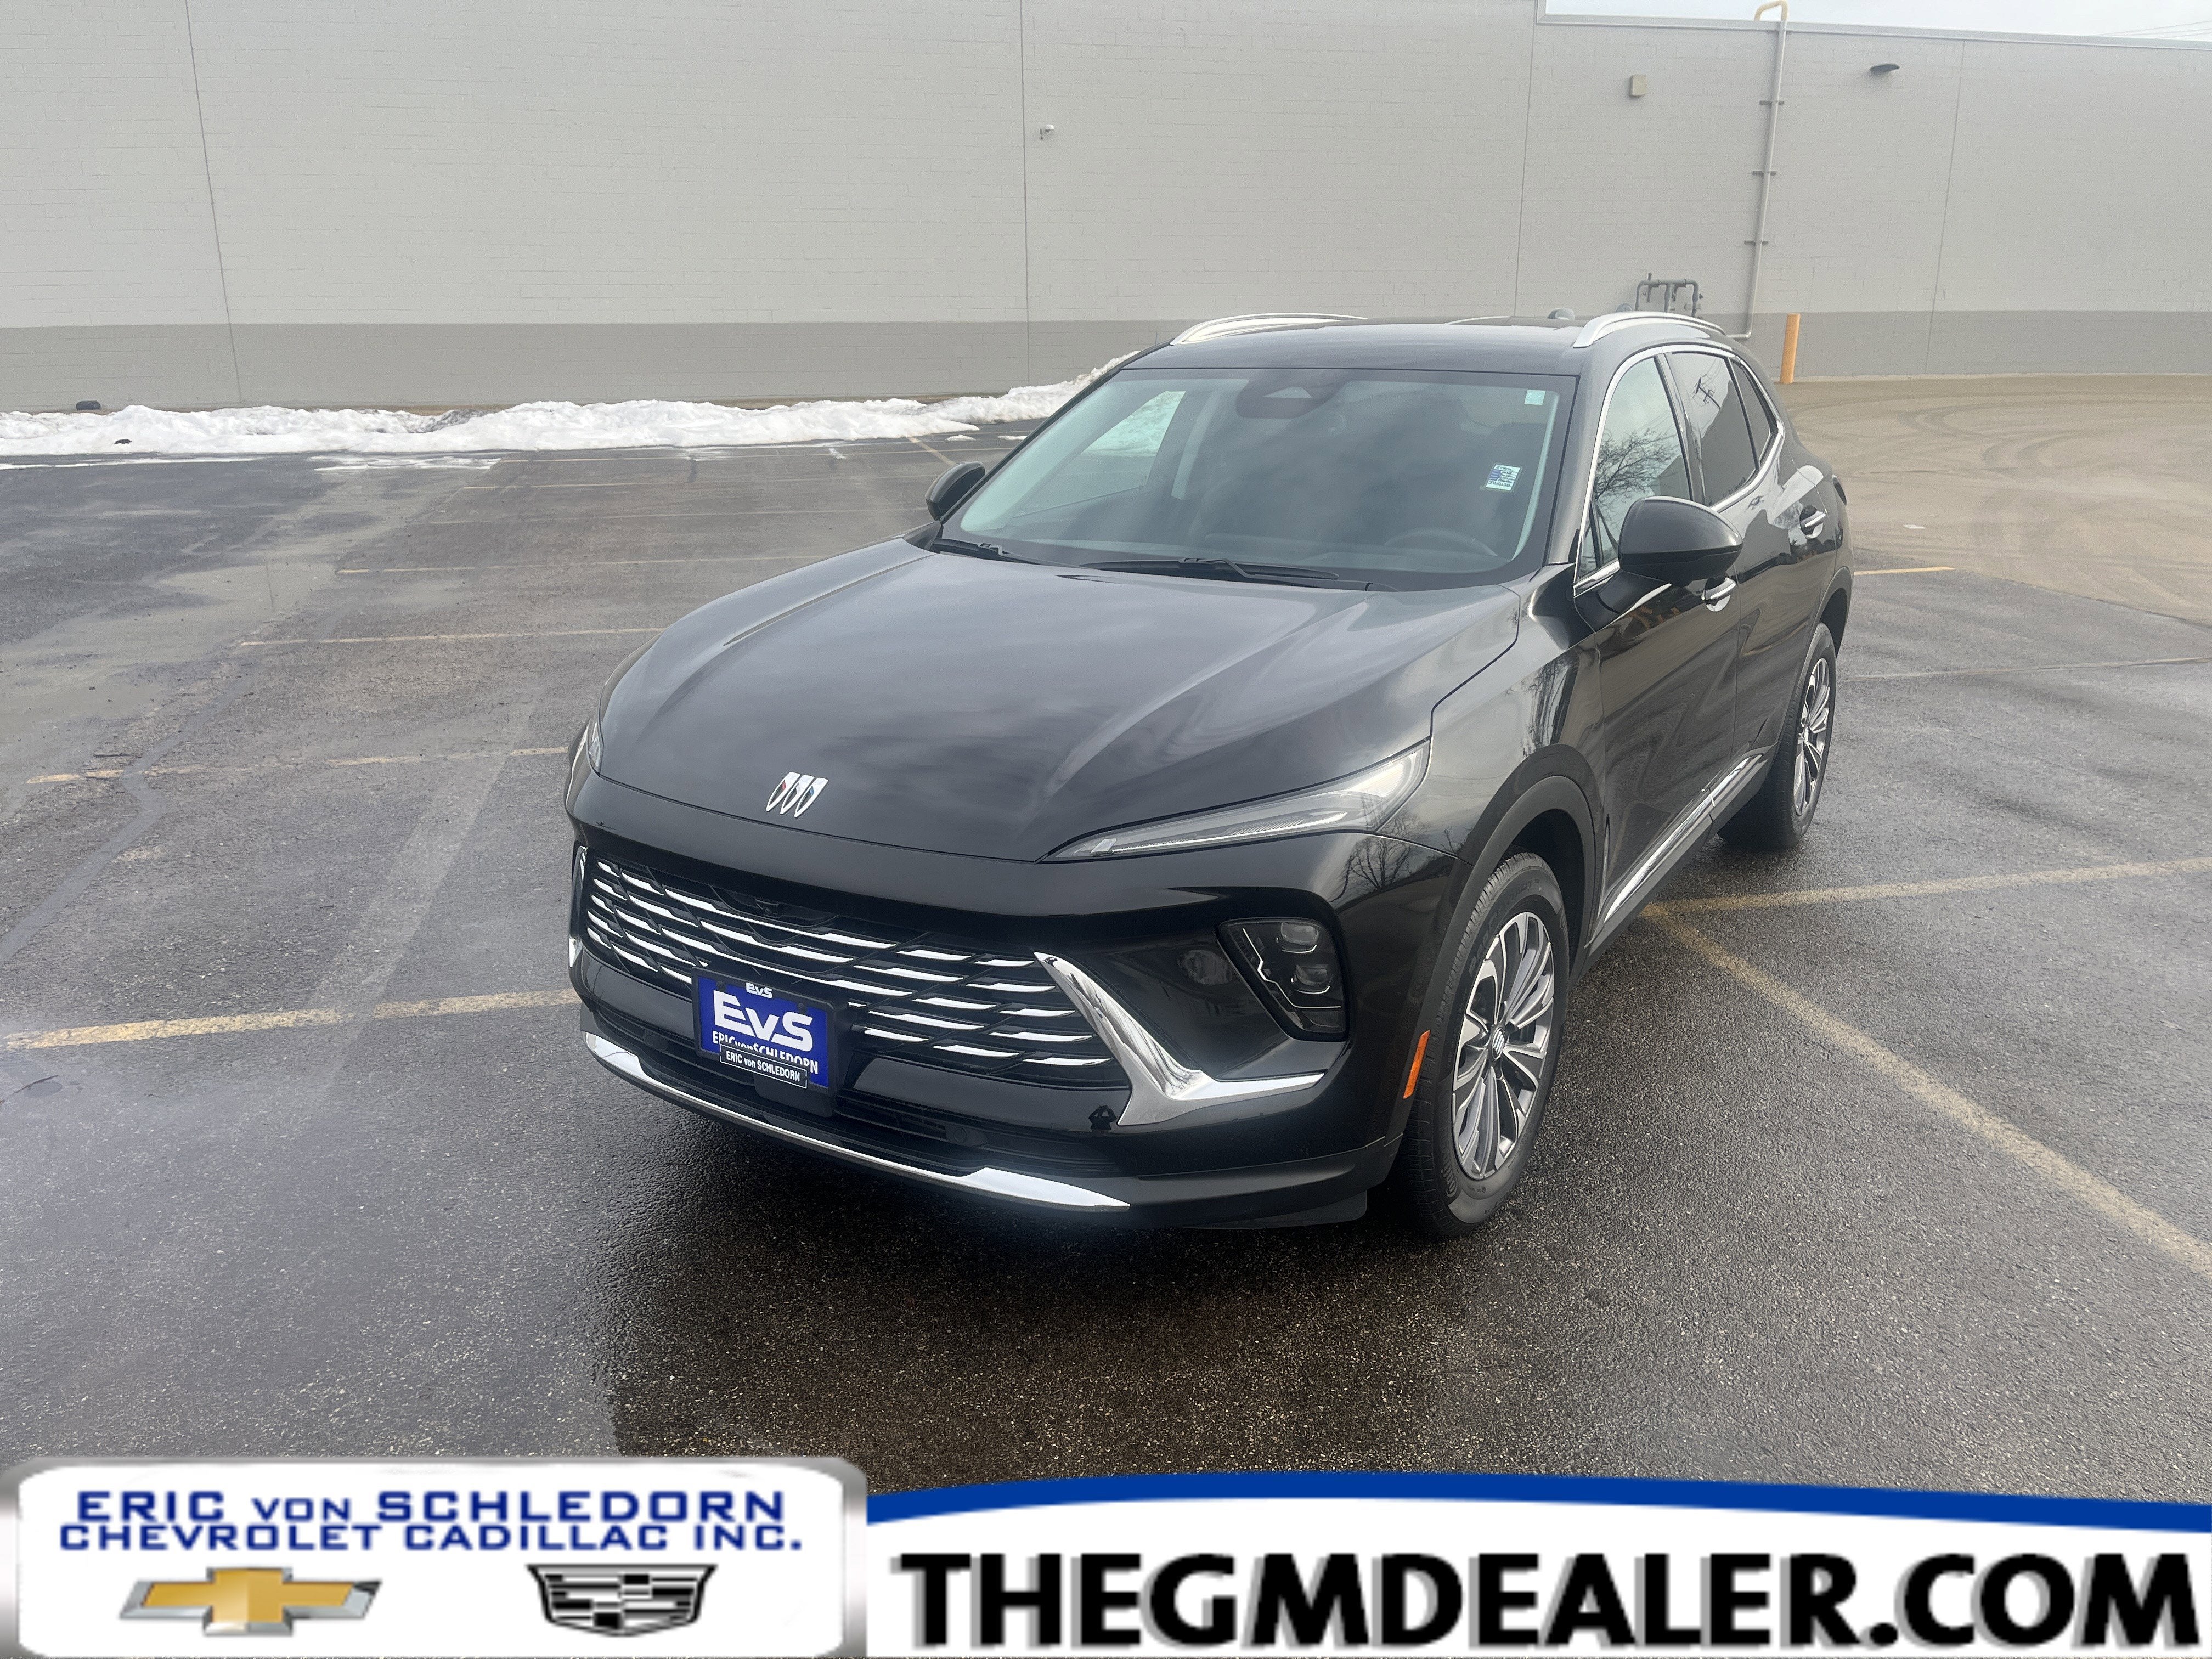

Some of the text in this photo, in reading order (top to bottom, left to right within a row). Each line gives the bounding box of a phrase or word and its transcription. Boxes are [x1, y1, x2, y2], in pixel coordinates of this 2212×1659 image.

[726, 1050, 800, 1082] ERIC von SCHLEDORN
